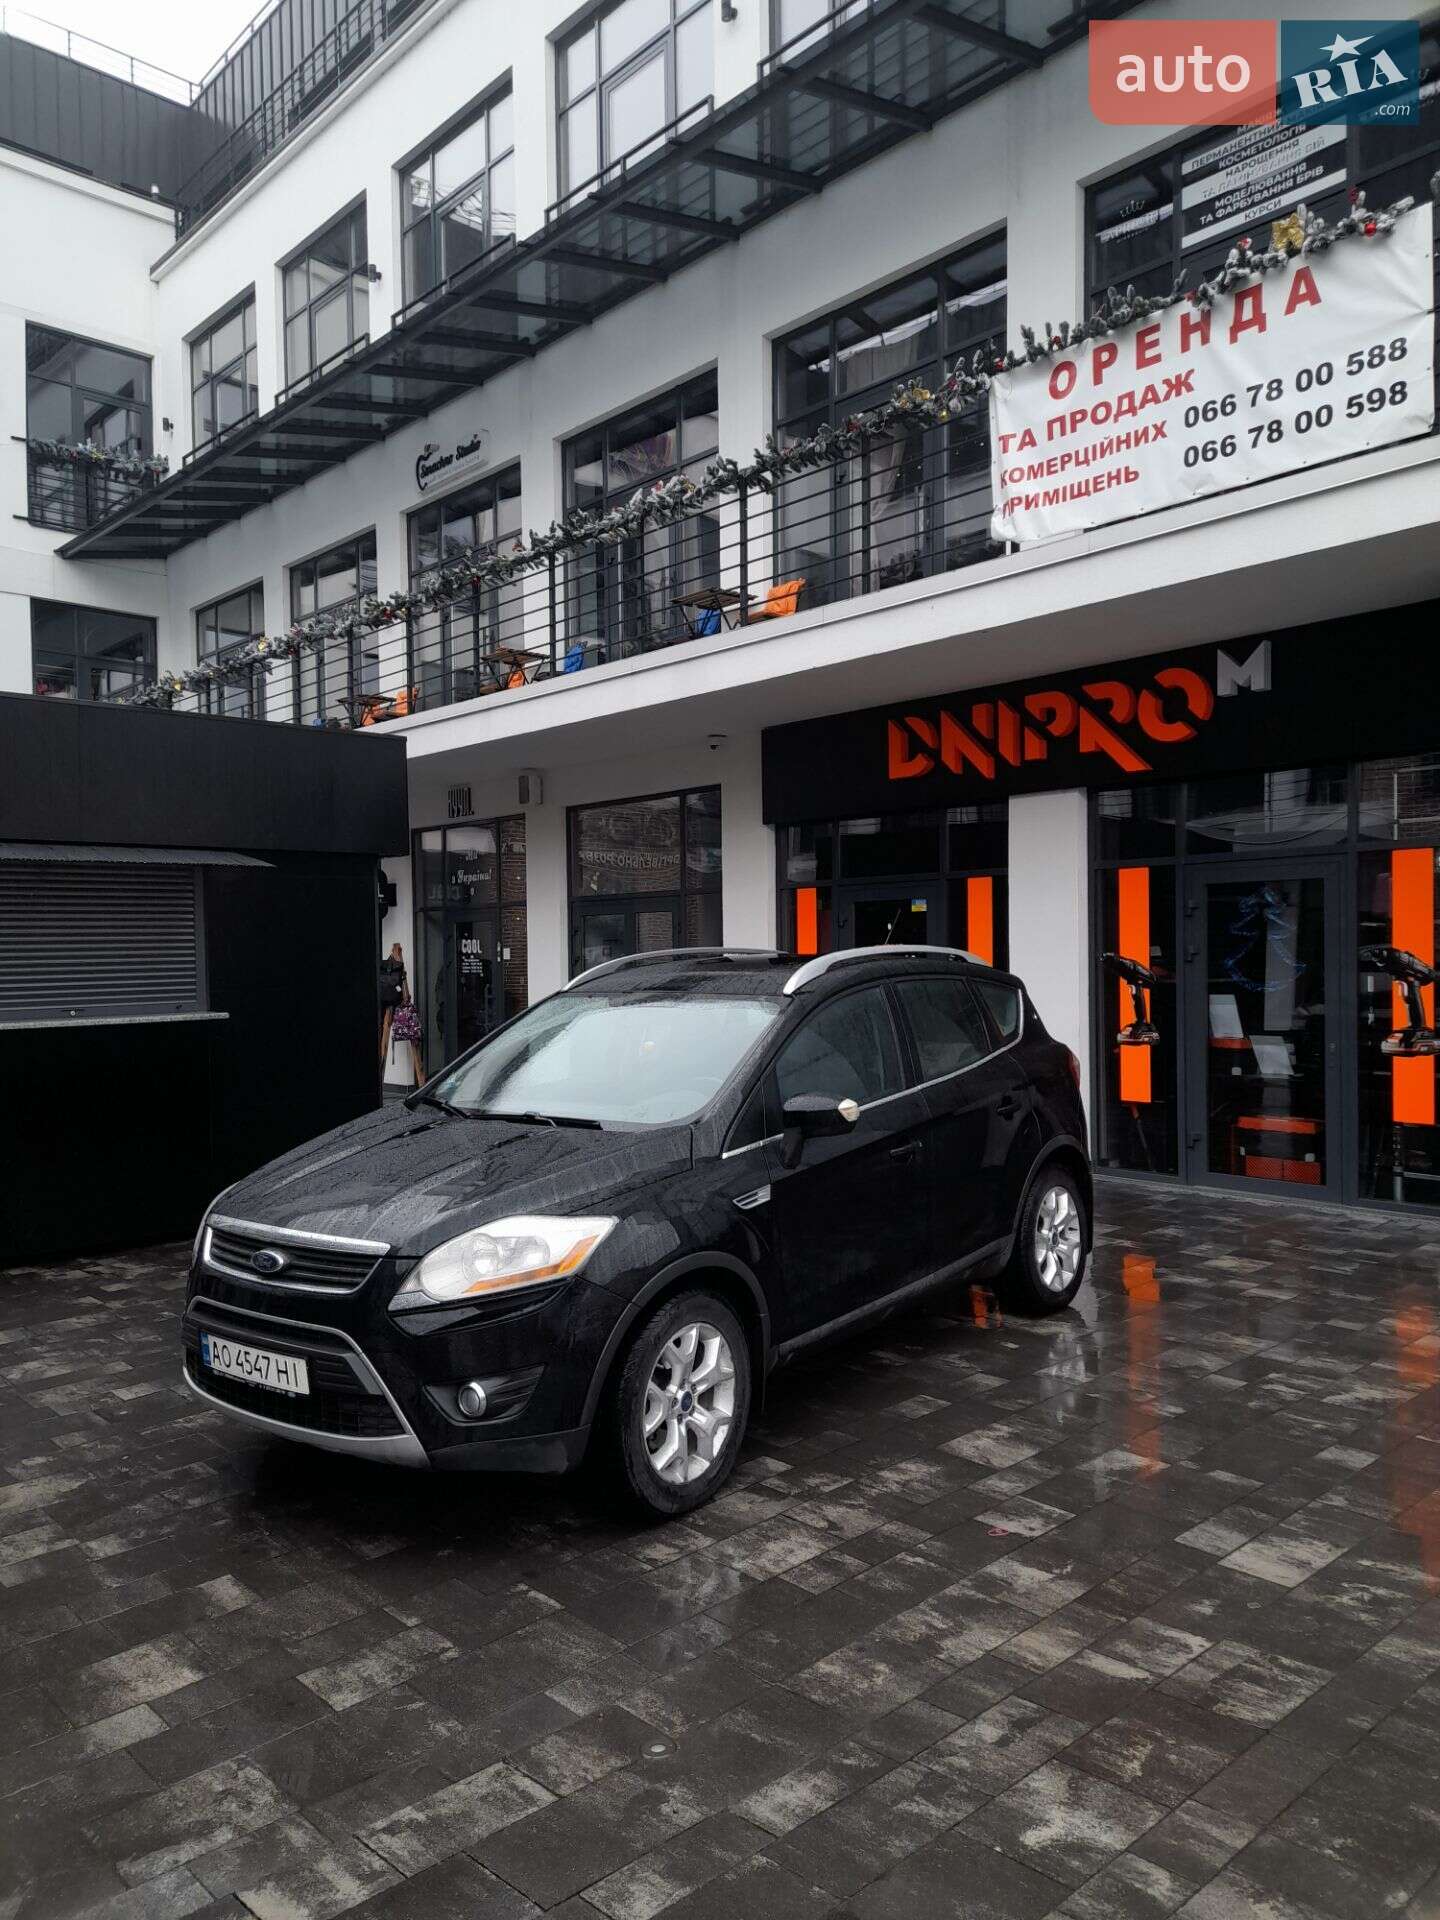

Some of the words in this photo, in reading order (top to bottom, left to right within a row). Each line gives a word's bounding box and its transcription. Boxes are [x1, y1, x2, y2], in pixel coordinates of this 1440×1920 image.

[1218, 124, 1307, 169] КОСМЕТОЛОГІЯ
[1225, 138, 1300, 179] НАРОЩЕННЯ
[1200, 213, 1214, 226] ТА
[1215, 181, 1294, 219] ФАРБУВАННЯ
[1296, 165, 1325, 184] БРІВ
[1214, 162, 1307, 209] МОДЕЛЮВАННЯ
[1244, 198, 1282, 221] КУРСИ
[1049, 265, 1322, 400] ОРЕНДА
[999, 428, 1038, 454] ТА
[1047, 368, 1195, 442] ПРОДАЖ
[1184, 393, 1237, 428] 066
[1246, 378, 1284, 408] 78
[1295, 362, 1334, 393] 00
[1346, 337, 1408, 376] 588
[1183, 434, 1237, 467] 066
[1247, 419, 1284, 449] 78
[1294, 404, 1333, 434] 00
[1345, 380, 1408, 419] 598
[1000, 420, 1168, 489] КОМЕРЦІЙНИХ
[1002, 465, 1140, 519] ПРИМІЩЕНЬ
[888, 667, 1214, 781] DNIPRO
[1216, 639, 1272, 698] M
[461, 939, 482, 954] COOL
[212, 1341, 233, 1368] AO
[236, 1349, 270, 1380] 4547
[275, 1359, 298, 1388] HI
